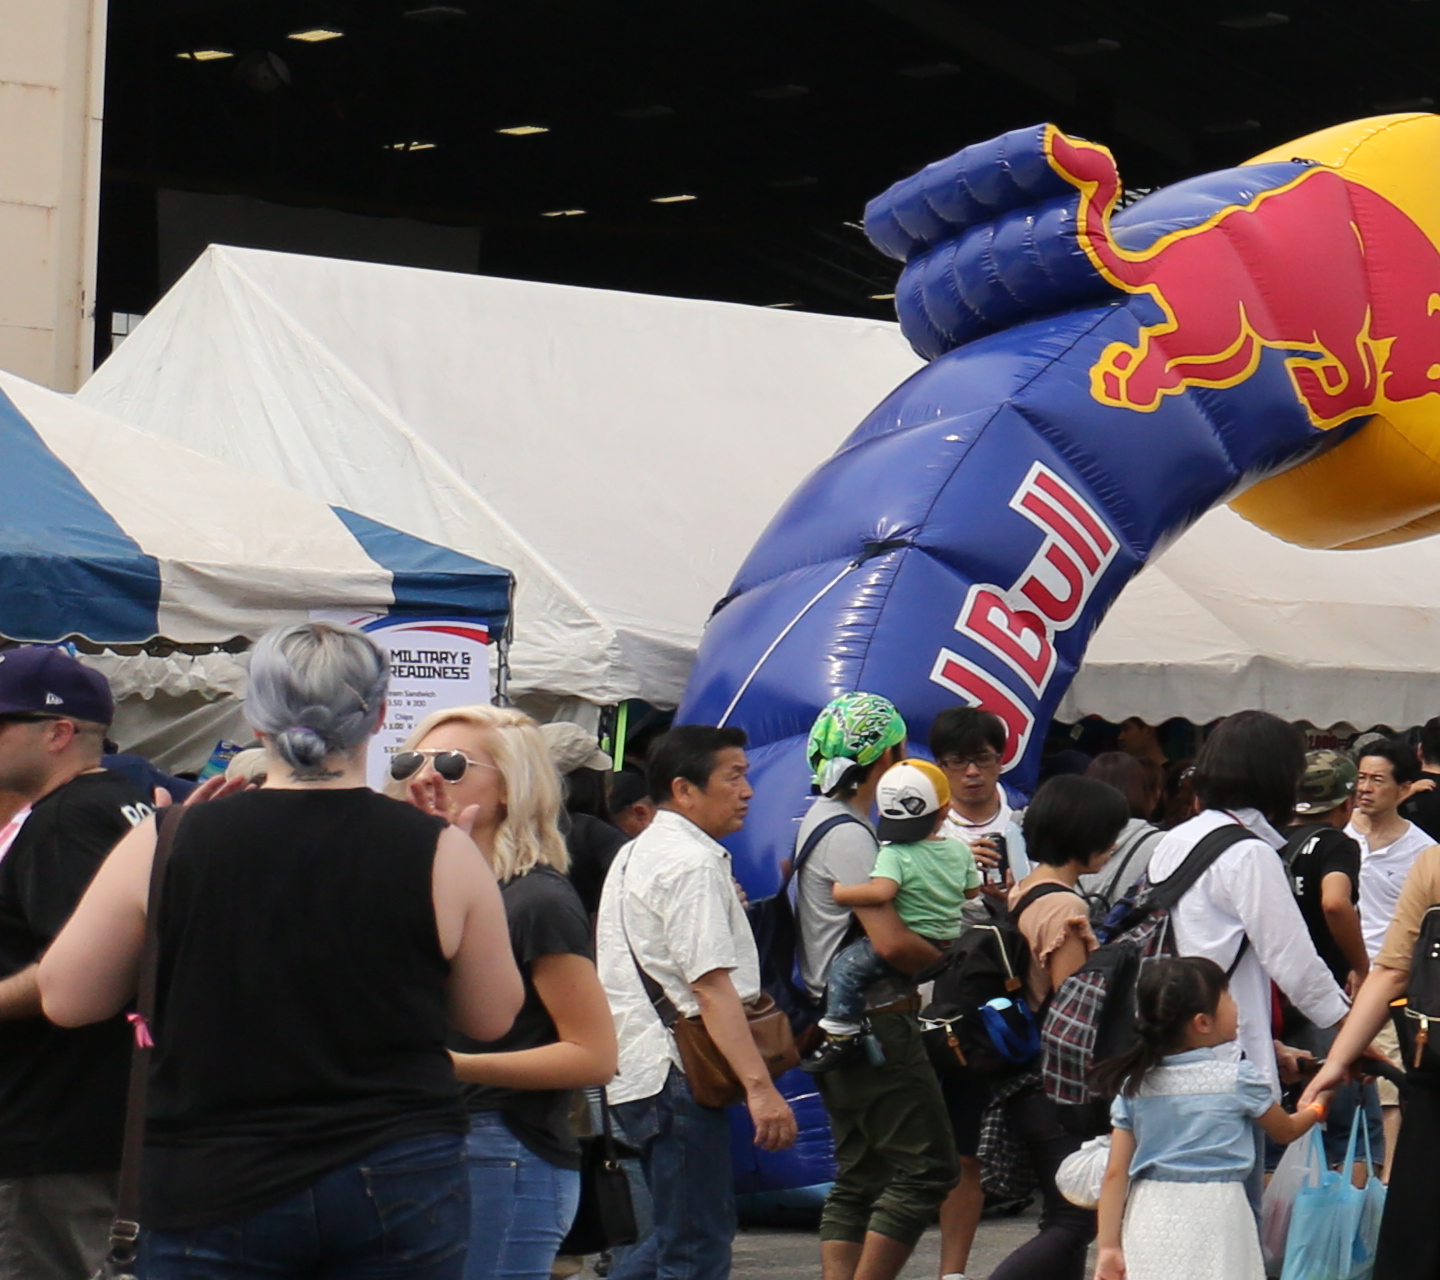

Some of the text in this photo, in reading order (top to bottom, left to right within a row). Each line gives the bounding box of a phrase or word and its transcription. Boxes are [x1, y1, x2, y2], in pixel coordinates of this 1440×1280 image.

[960, 466, 1117, 694] Bull
[390, 650, 471, 665] MILITARY &
